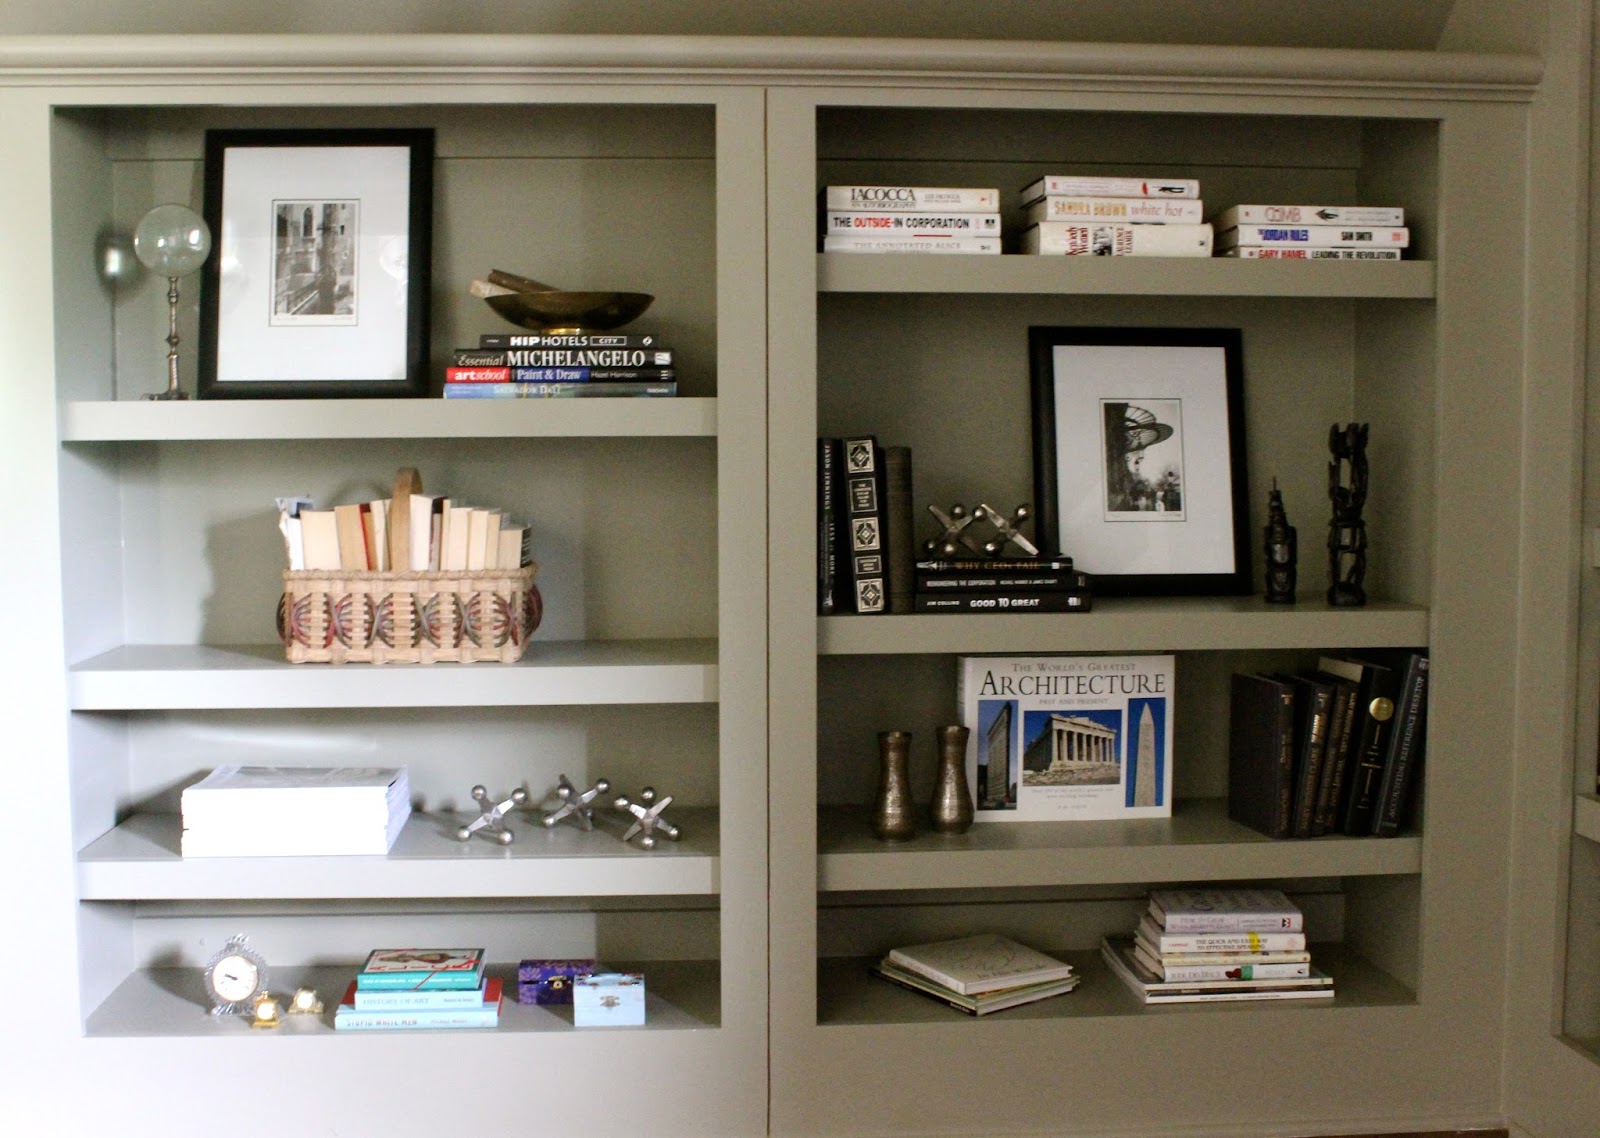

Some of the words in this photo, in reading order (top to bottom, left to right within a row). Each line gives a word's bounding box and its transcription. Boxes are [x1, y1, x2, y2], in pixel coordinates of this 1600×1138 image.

[851, 188, 916, 201] IACOCCA
[1055, 201, 1091, 216] SANDRA
[1093, 202, 1127, 216] BROWN
[1131, 202, 1161, 216] white
[1165, 202, 1184, 216] hot
[833, 217, 852, 228] THE
[906, 217, 970, 229] CORPORATION
[1258, 250, 1278, 259] GARY
[1281, 250, 1307, 259] HAMEL
[1312, 251, 1339, 259] LEADING
[1342, 251, 1354, 259] THE
[1356, 251, 1397, 259] REVOLUTION
[510, 336, 541, 346] HIP
[541, 336, 588, 346] HOTELS
[458, 354, 504, 367] Essential
[507, 350, 646, 367] MICHELANGELO
[517, 369, 543, 380] Paint
[544, 369, 555, 380] &
[556, 369, 582, 380] Draw
[956, 562, 980, 570] WHY
[970, 599, 996, 608] GOOD
[998, 598, 1009, 607] TO
[1011, 599, 1040, 607] GREAT
[1012, 663, 1032, 672] THE
[1037, 662, 1083, 672] WORLD'S
[1088, 662, 1136, 672] GREATEST
[979, 670, 1166, 696] ARCHITECTURE
